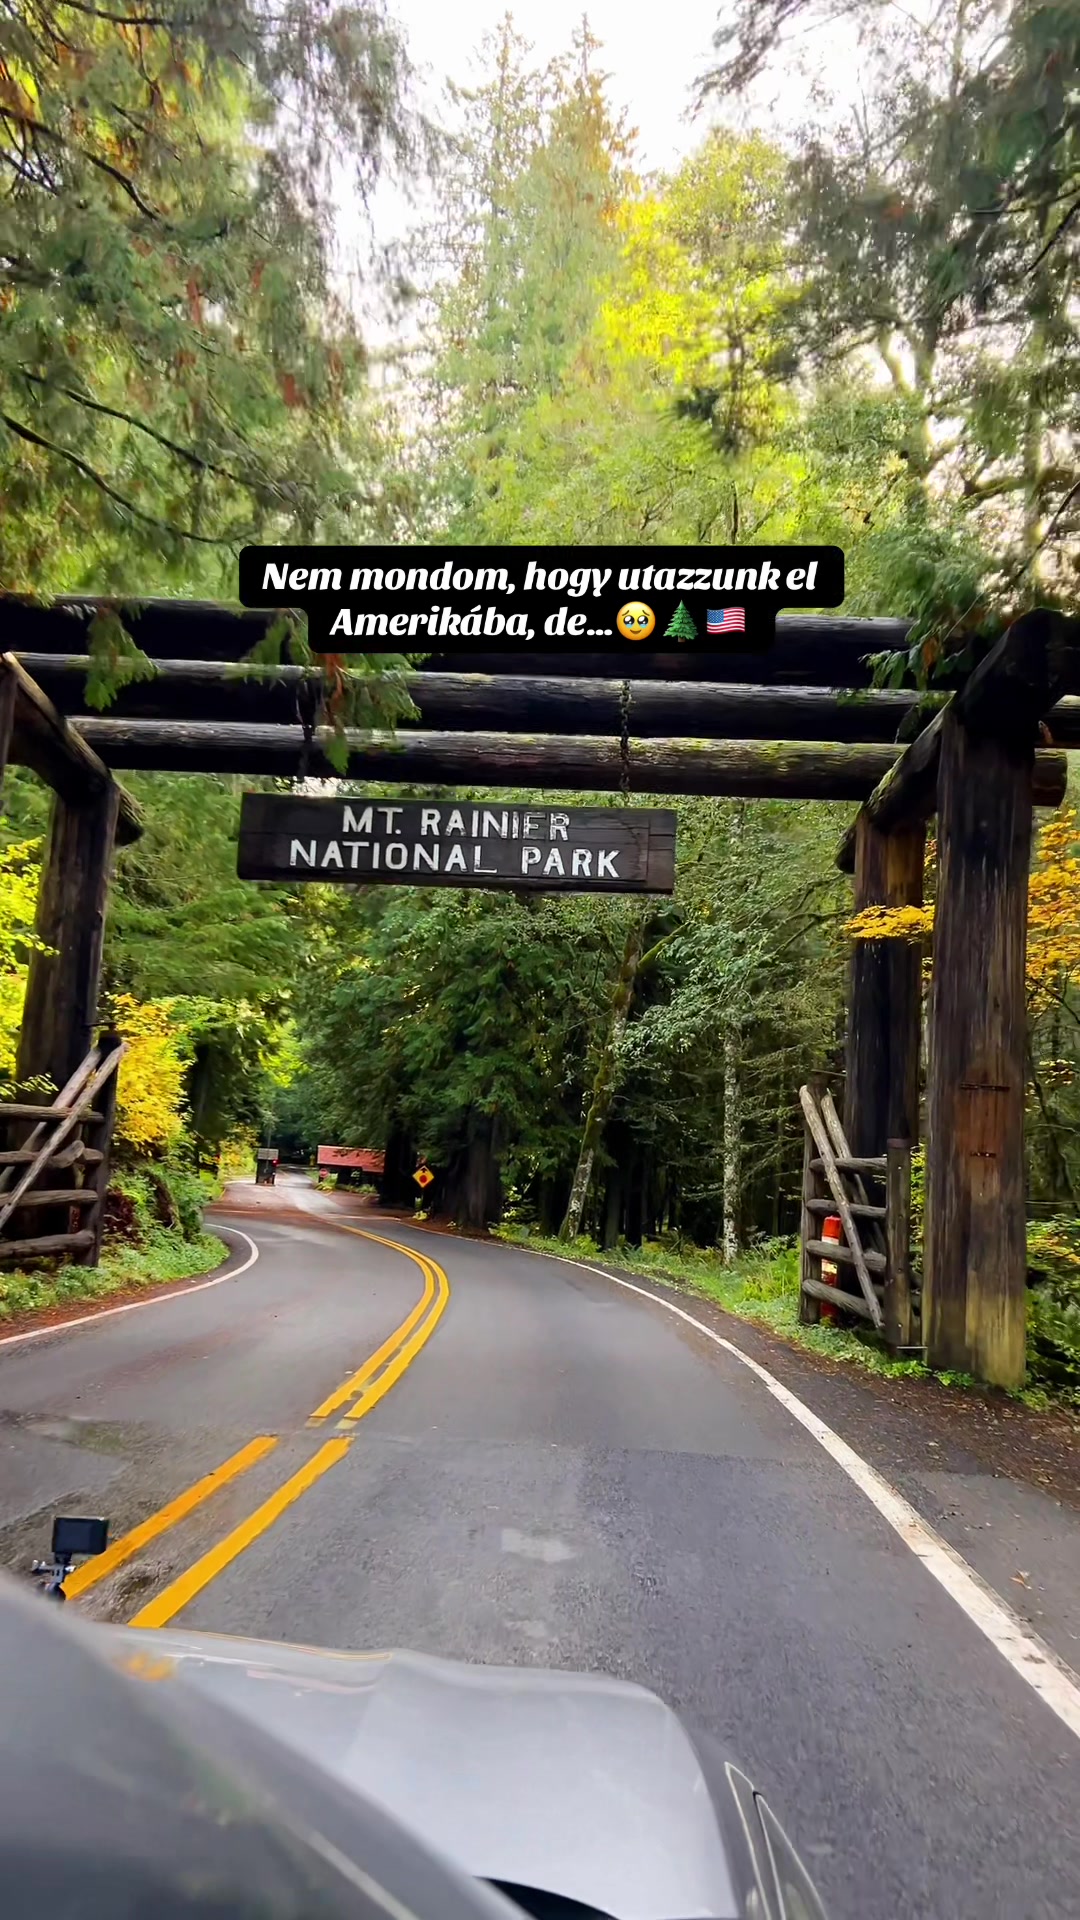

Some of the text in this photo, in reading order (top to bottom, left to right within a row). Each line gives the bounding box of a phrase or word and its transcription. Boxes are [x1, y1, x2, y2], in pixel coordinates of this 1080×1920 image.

[342, 806, 570, 841] MT. RAINIER
[290, 839, 620, 878] NATIONAL PARK
